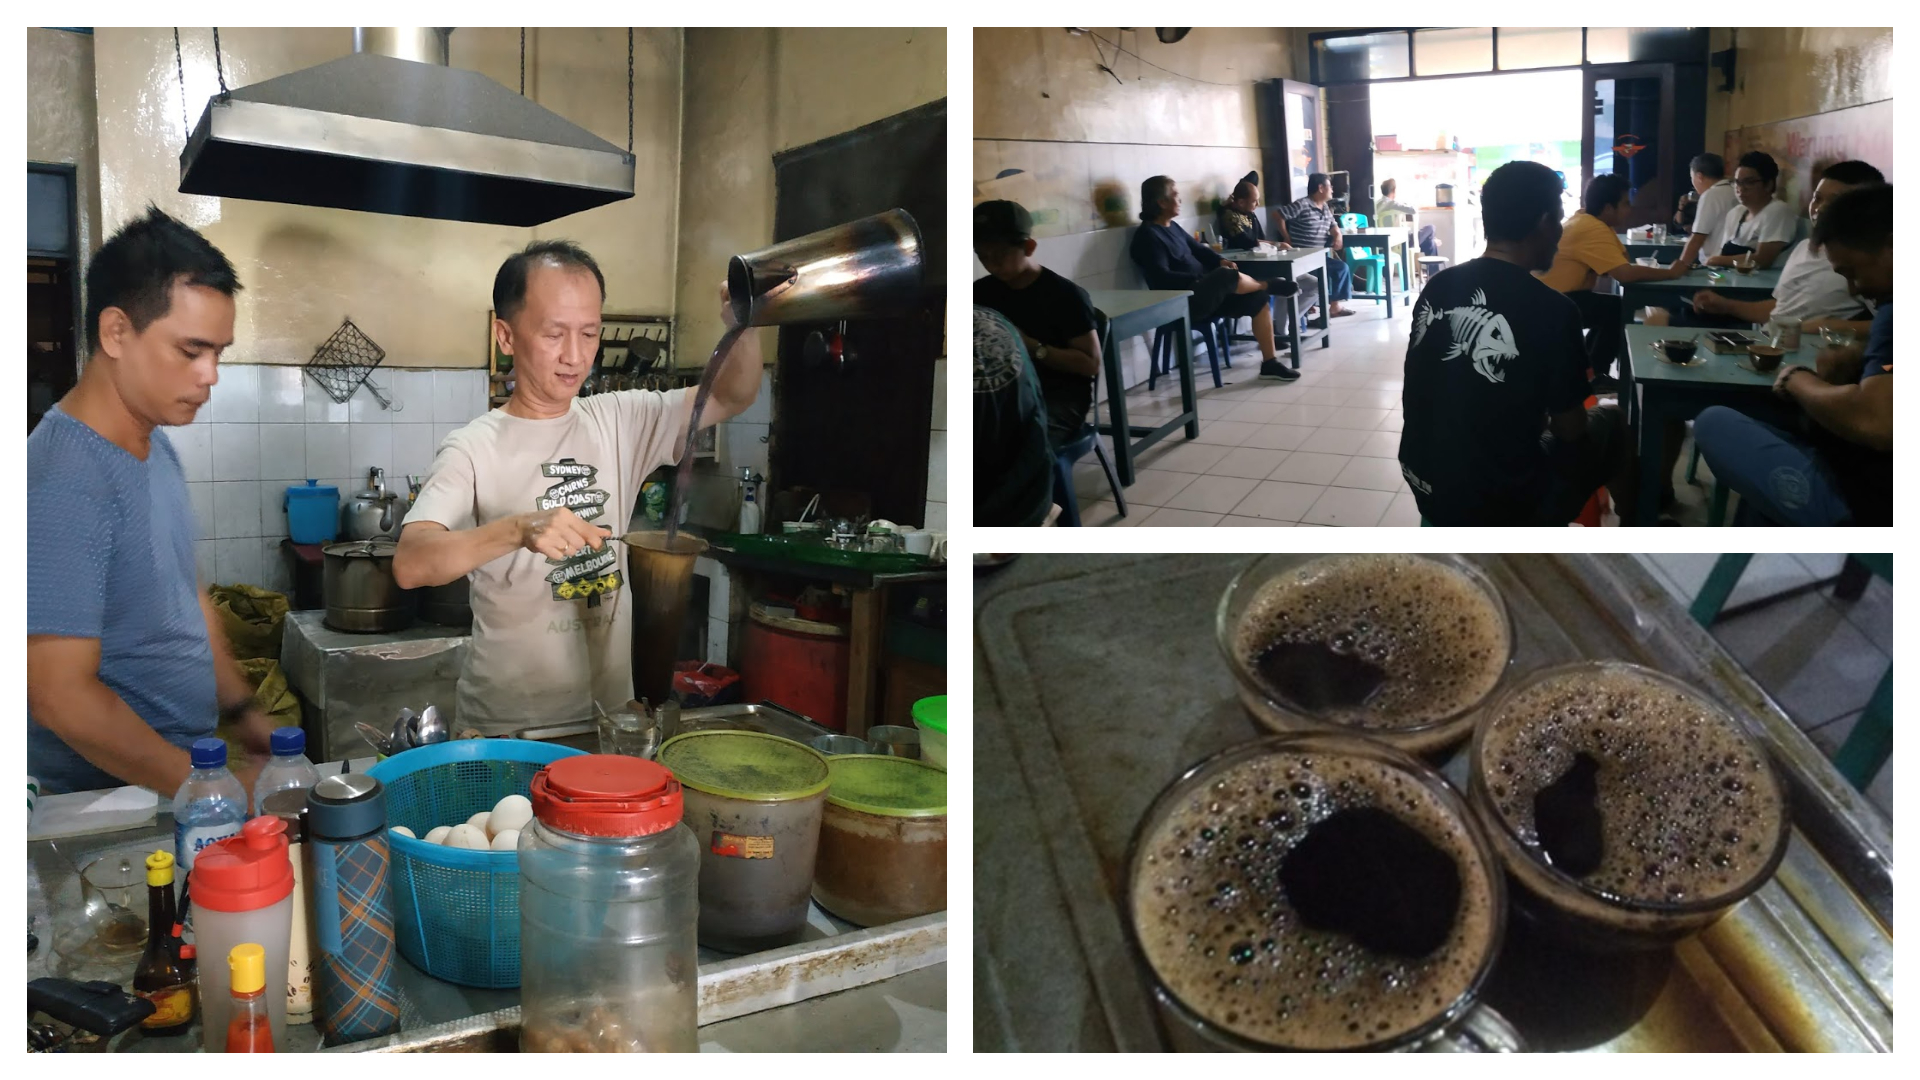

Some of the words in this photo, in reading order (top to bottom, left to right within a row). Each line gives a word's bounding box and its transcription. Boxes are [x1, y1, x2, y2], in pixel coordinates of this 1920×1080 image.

[550, 464, 581, 475] SYDNEY
[558, 477, 589, 496] CAIRNS
[542, 496, 566, 511] GOLD
[567, 493, 596, 506] COAST
[574, 506, 599, 519] RWIN
[546, 614, 614, 635] AUSTRA
[193, 833, 236, 852] AQ
